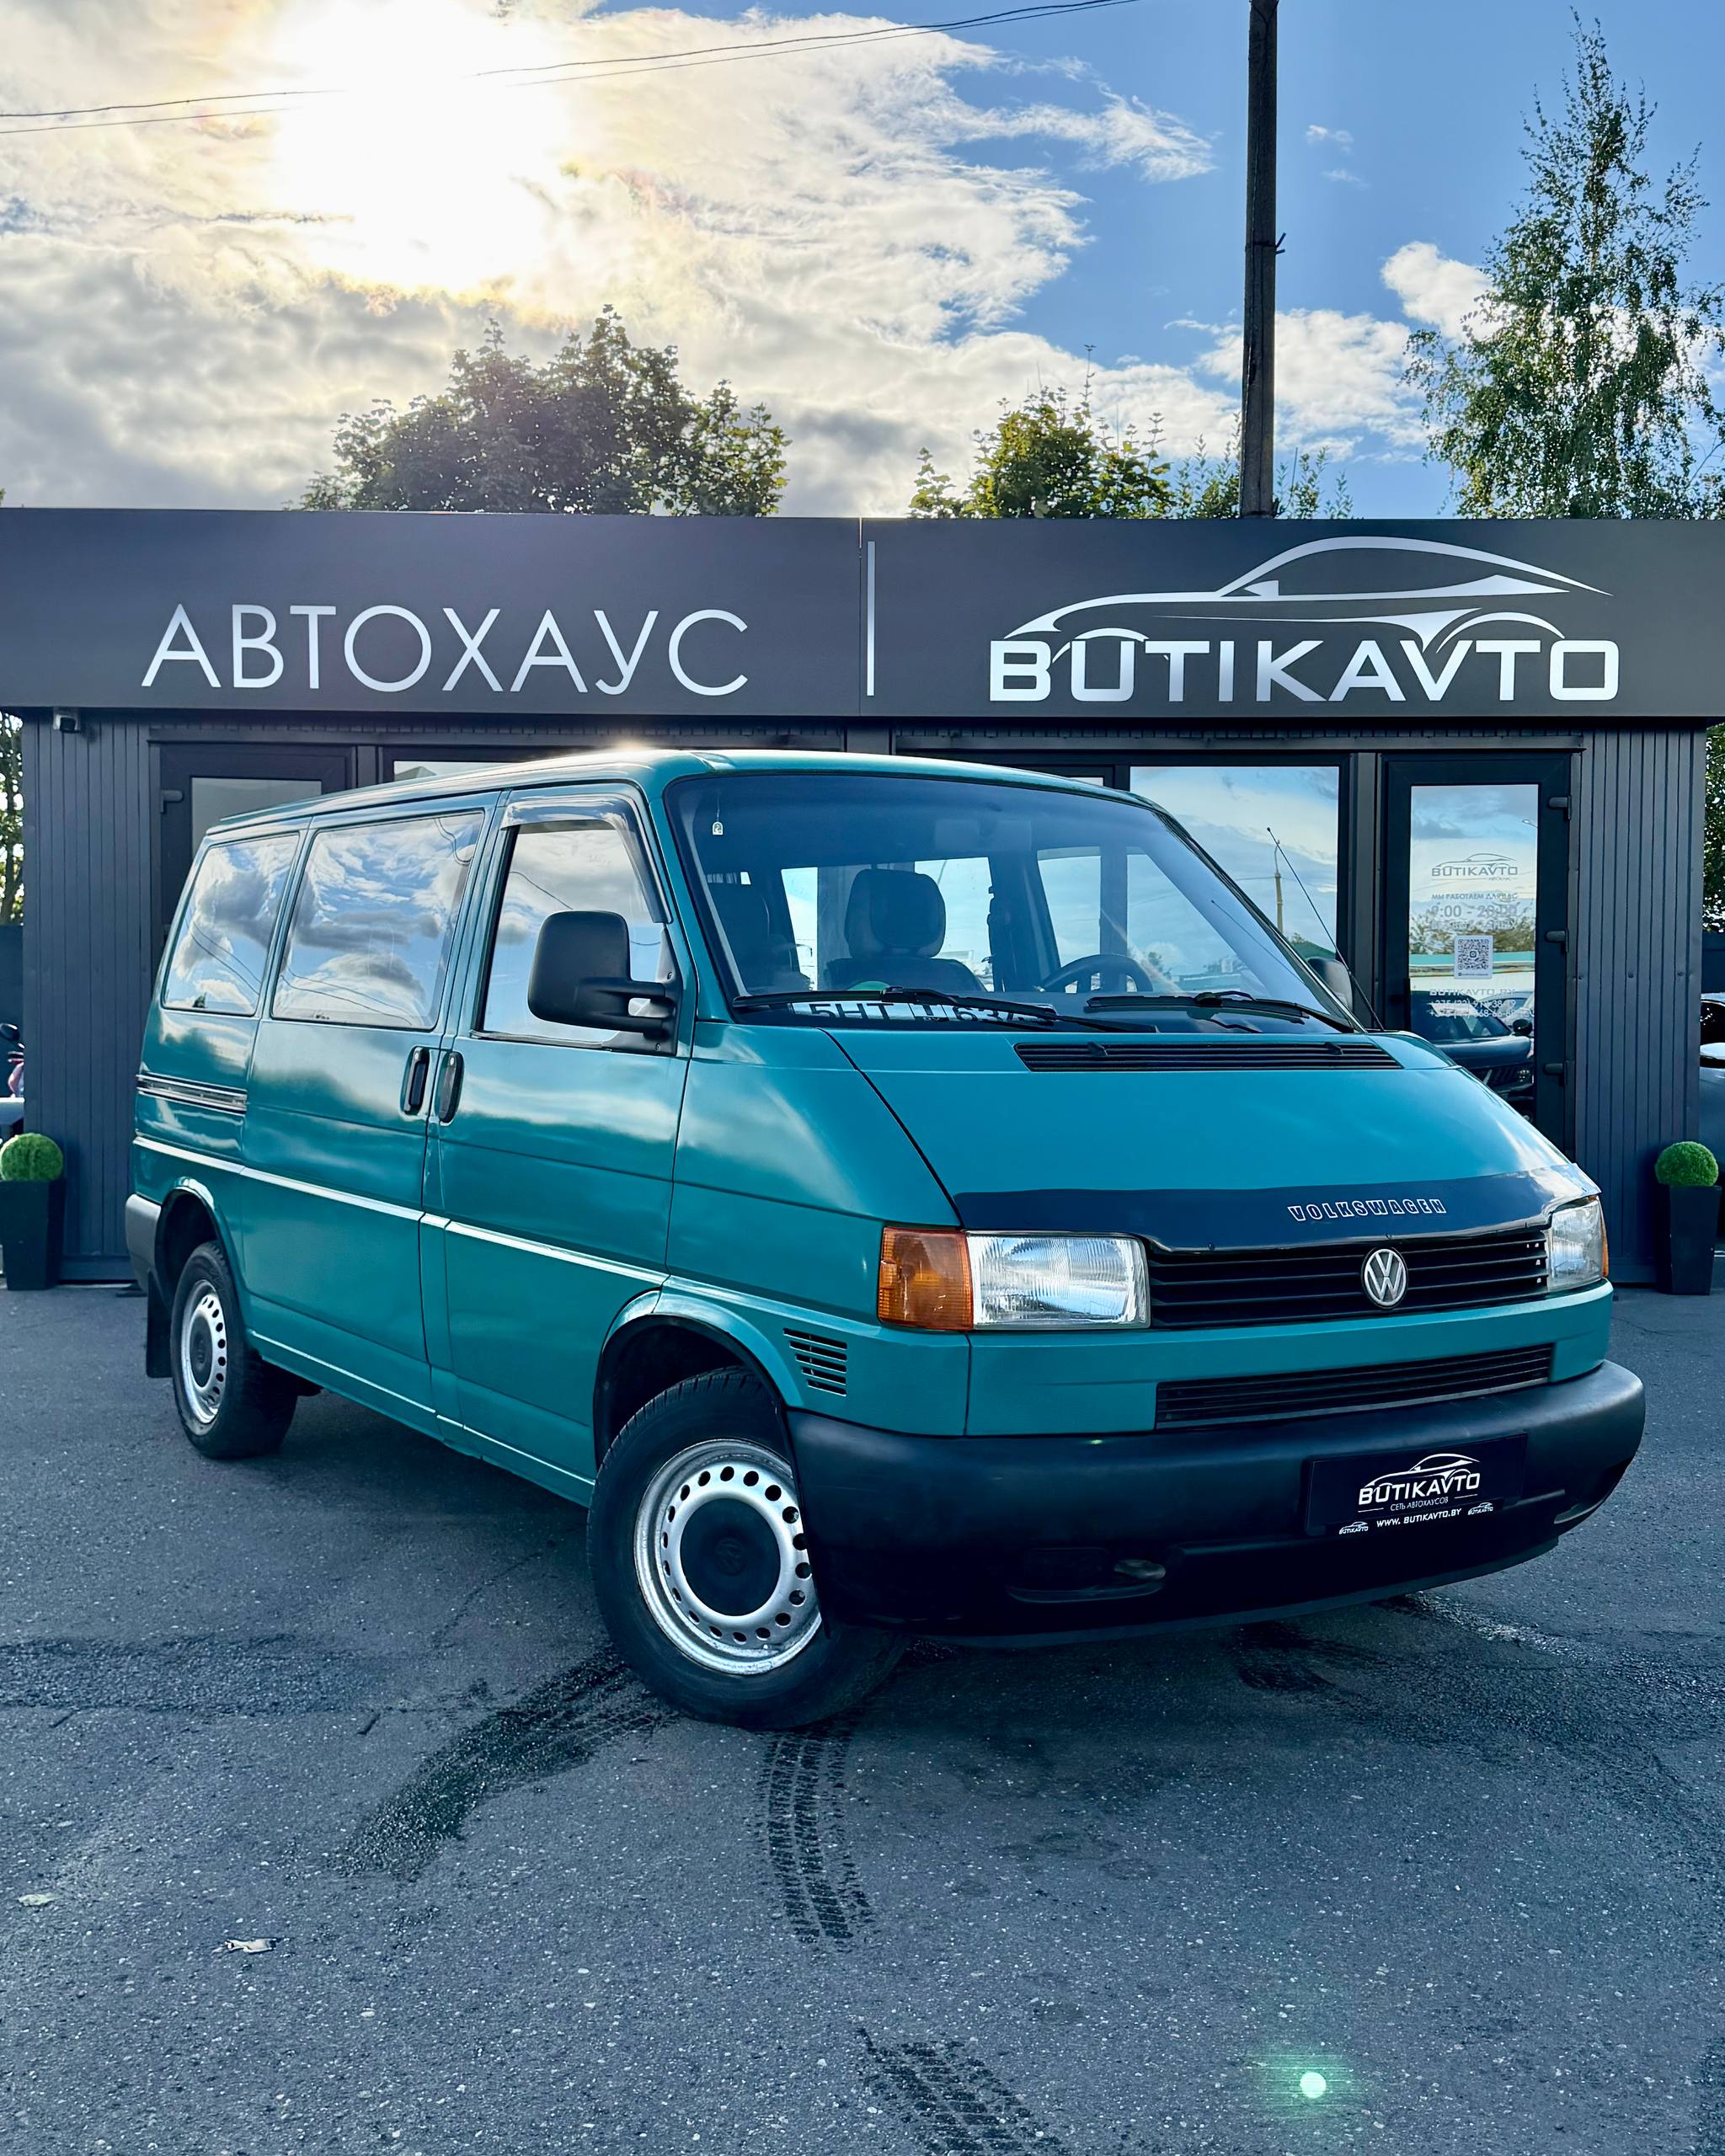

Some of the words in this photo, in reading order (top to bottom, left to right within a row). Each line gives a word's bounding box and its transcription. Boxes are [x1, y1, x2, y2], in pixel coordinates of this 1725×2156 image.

[142, 603, 750, 696] АВТОХАУС
[990, 638, 1619, 702] BUTIKAVTO
[1431, 866, 1519, 877] BUTIKAVTO
[1431, 905, 1461, 917] 9:00
[1287, 1198, 1447, 1222] VOLKSWAGEN
[1358, 1473, 1481, 1505] BUTIKAVTO
[1390, 1502, 1406, 1512] СЕТЬ
[1407, 1497, 1449, 1509] АВТОХАУСОВ
[1376, 1518, 1401, 1528] WWW.
[1403, 1508, 1462, 1524] BUTIKAVTO.BY
